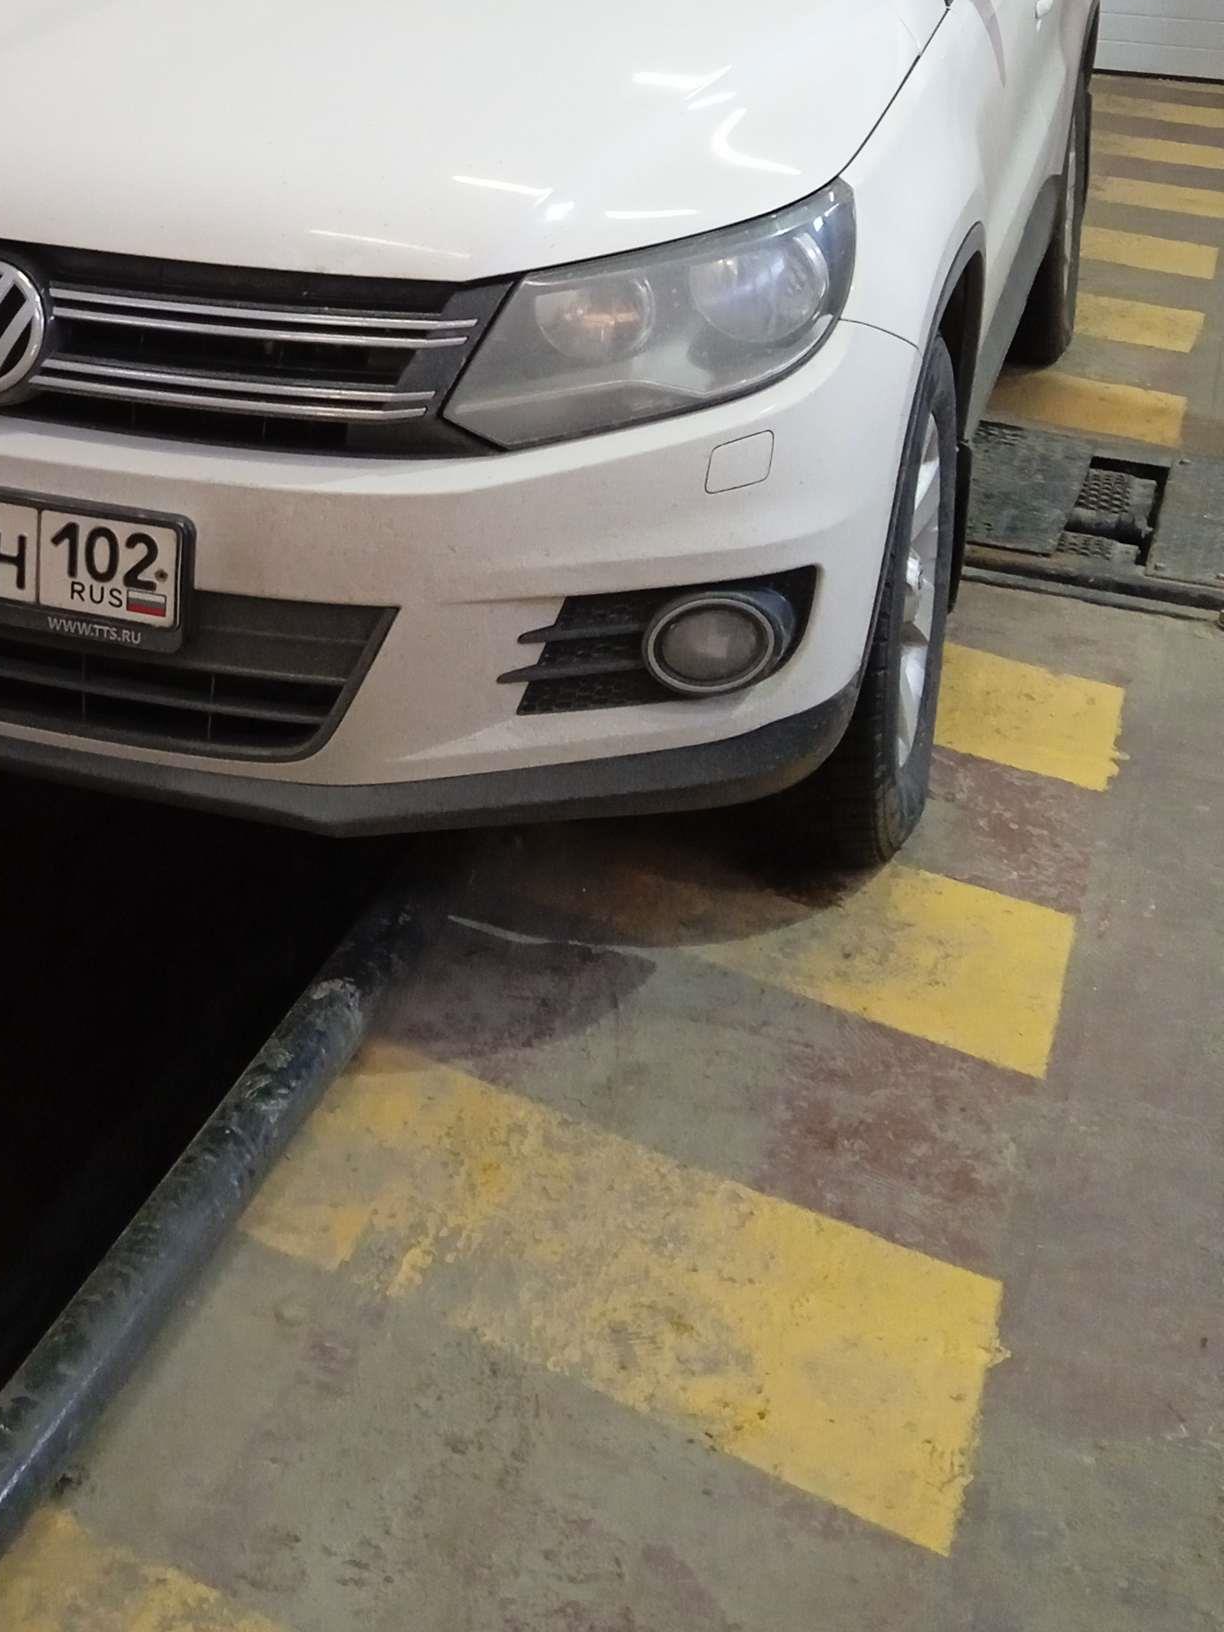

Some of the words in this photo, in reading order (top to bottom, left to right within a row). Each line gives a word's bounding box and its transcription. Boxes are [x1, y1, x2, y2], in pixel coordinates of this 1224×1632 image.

[51, 522, 158, 591] 102
[71, 581, 123, 608] RUS
[48, 616, 142, 645] WWW.TTS.RU
